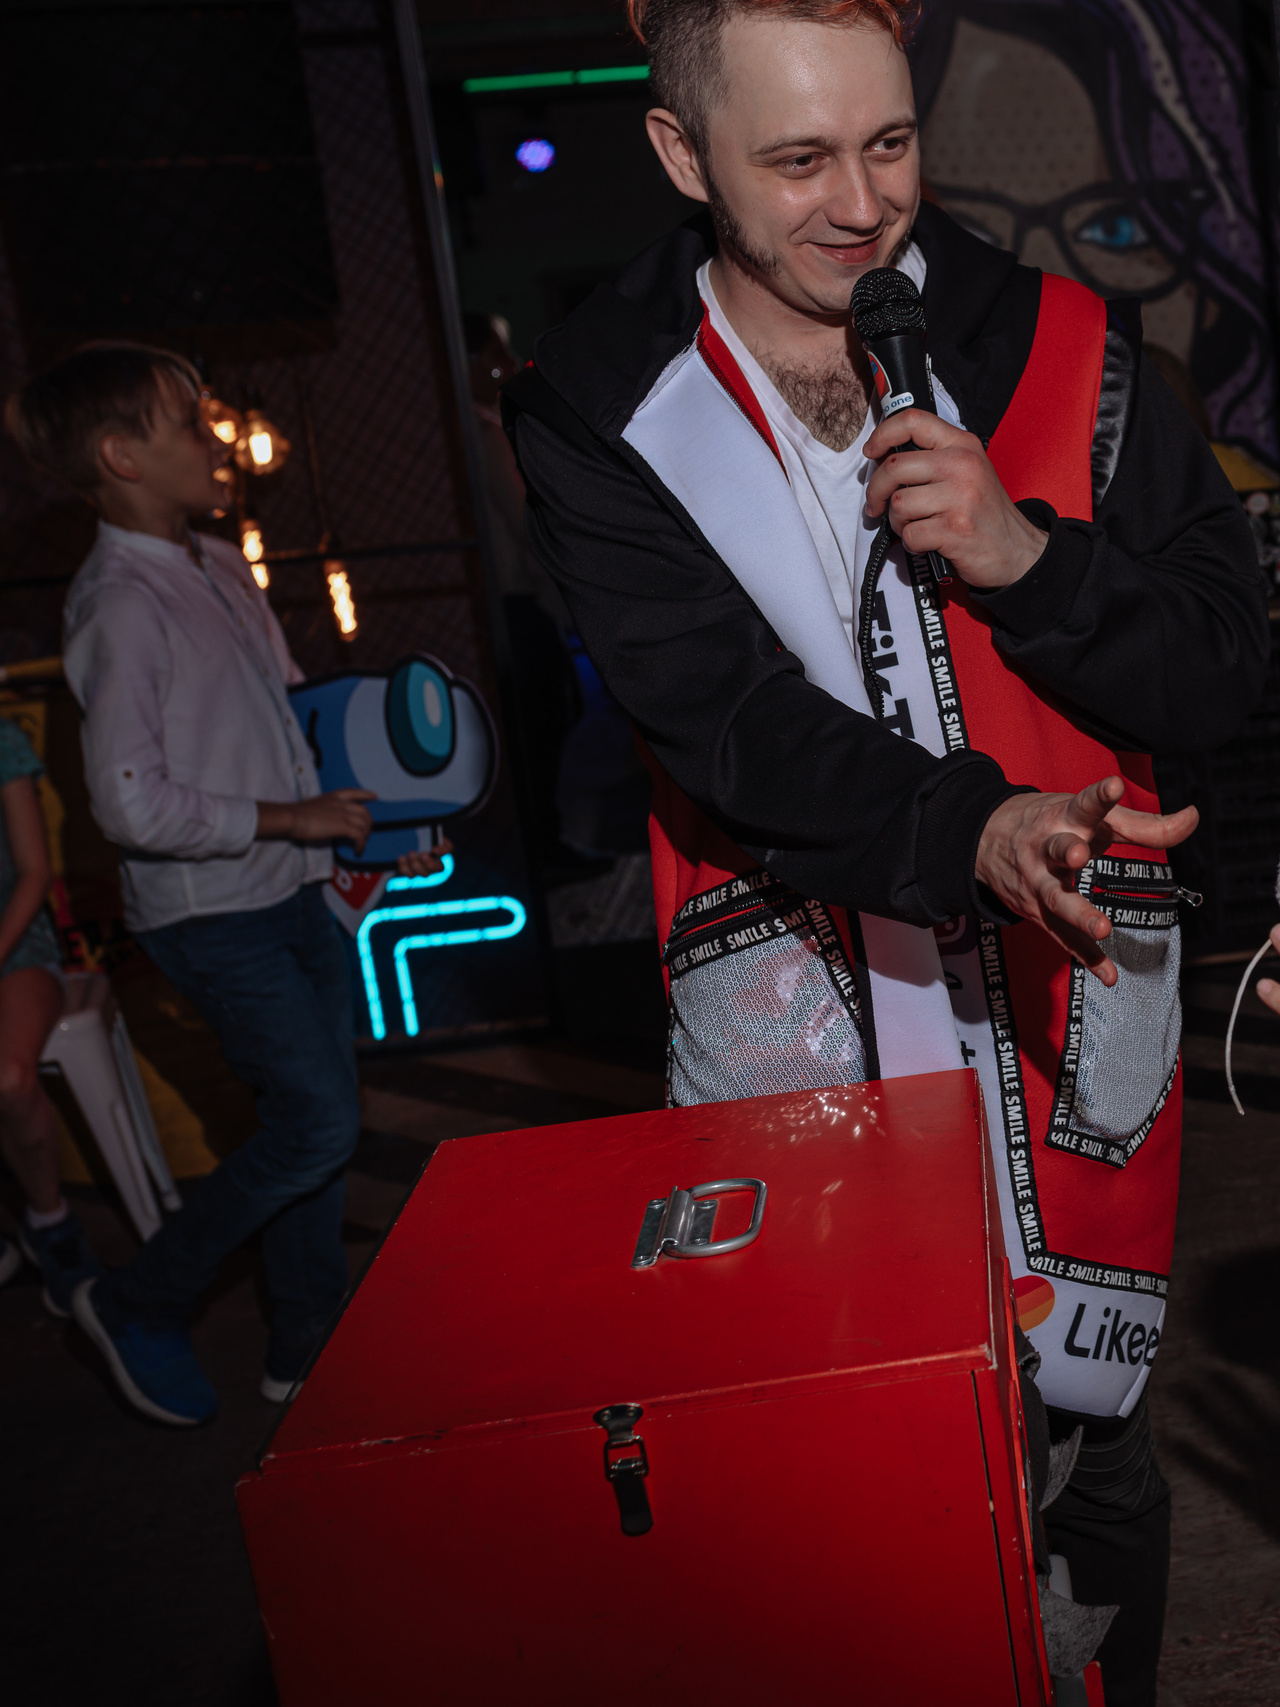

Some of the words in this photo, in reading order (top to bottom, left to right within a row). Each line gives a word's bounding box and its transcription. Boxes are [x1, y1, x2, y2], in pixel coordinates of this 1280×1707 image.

[890, 395, 912, 408] one
[920, 597, 946, 650] SMILE
[931, 655, 957, 709] SMILE
[696, 886, 728, 913] SMILE
[731, 871, 772, 898] SMILE
[1124, 863, 1151, 879] SMILE
[1113, 908, 1148, 925] SMILE
[689, 938, 723, 965] SMILE
[726, 922, 772, 950] SMILE
[805, 899, 838, 946] SMILE
[825, 949, 857, 998] SMILE
[981, 934, 1004, 985] SMILE
[989, 989, 1013, 1038] SMILE
[1072, 968, 1085, 1018] SMILE
[998, 1041, 1020, 1091] SMILE
[1064, 1022, 1082, 1073] SMILE
[1005, 1095, 1026, 1145] SMILE
[1053, 1076, 1075, 1126] SMILE
[1126, 1119, 1152, 1157] SMILE
[1011, 1149, 1032, 1199] SMILE
[1019, 1202, 1042, 1252] SMILE
[1065, 1263, 1102, 1283] SMILE
[1102, 1269, 1132, 1288] SMILE
[1064, 1303, 1160, 1367] Likee
